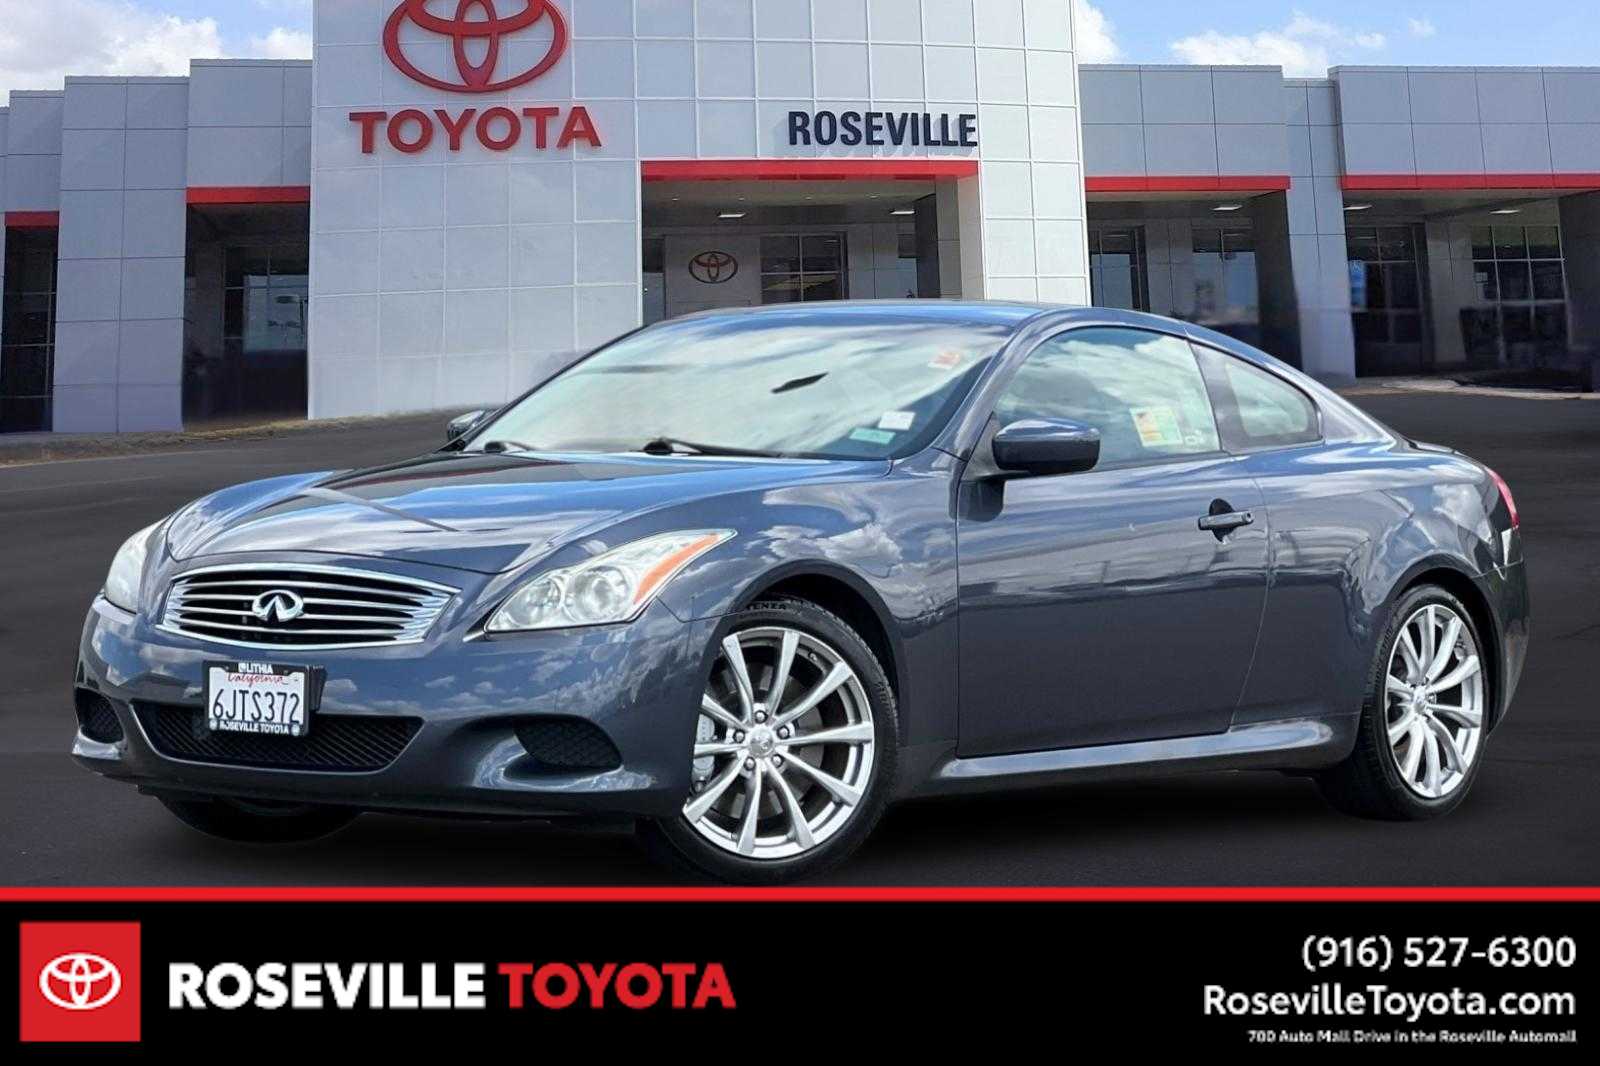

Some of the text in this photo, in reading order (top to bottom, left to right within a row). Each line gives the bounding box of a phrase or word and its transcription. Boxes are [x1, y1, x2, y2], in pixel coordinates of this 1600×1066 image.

[349, 107, 602, 153] TOYOTA
[789, 111, 978, 147] ROSEVILLE
[228, 674, 289, 687] California
[213, 689, 299, 724] 6JTS372
[260, 723, 289, 734] TOYOTA
